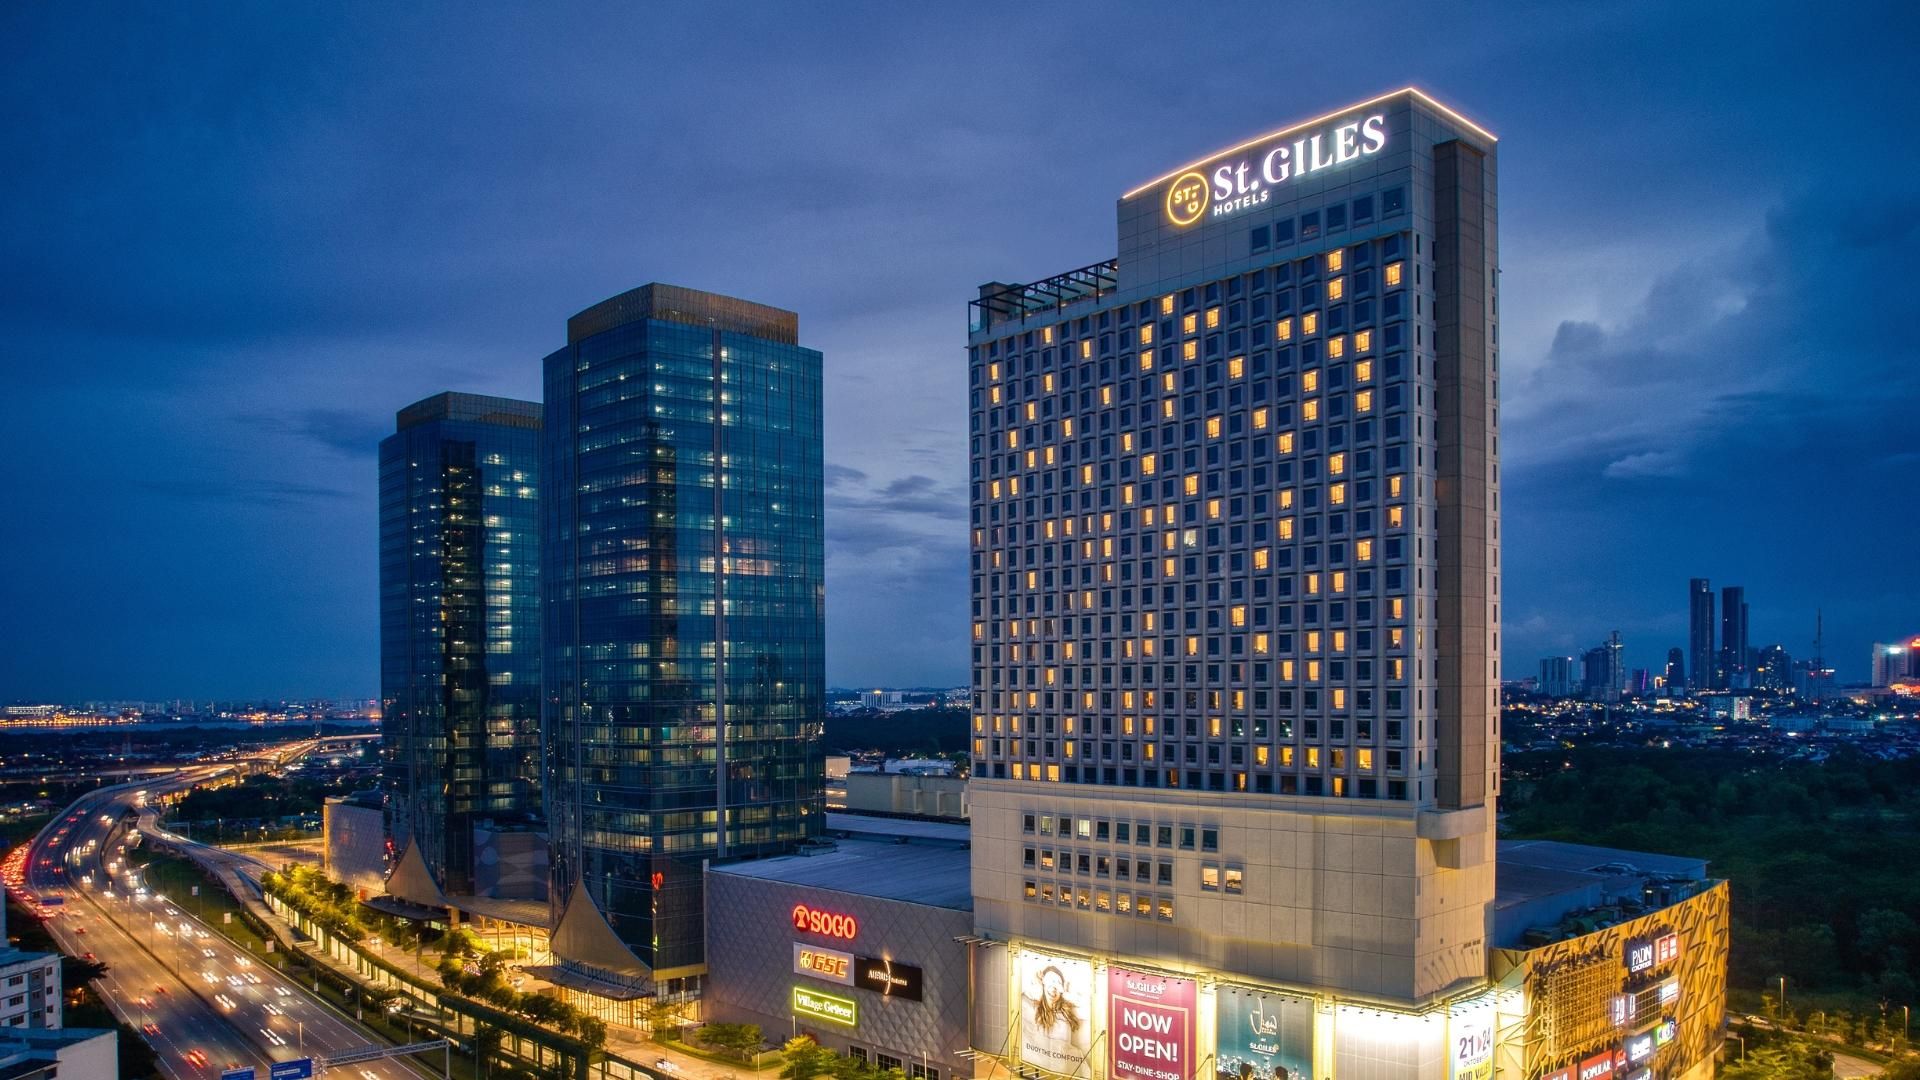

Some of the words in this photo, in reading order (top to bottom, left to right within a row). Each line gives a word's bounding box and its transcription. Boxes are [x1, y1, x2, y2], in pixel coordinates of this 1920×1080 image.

[1214, 190, 1268, 216] HOTELS
[810, 910, 856, 939] SOGO
[812, 953, 848, 977] GSC
[797, 993, 823, 1011] Village
[1124, 1007, 1172, 1034] NOW
[1041, 1048, 1051, 1058] THE
[1052, 1052, 1083, 1063] COMFORT
[1118, 1032, 1178, 1062] OPEN!
[1459, 1034, 1474, 1059] 21
[1582, 1059, 1611, 1080] POPULAR
